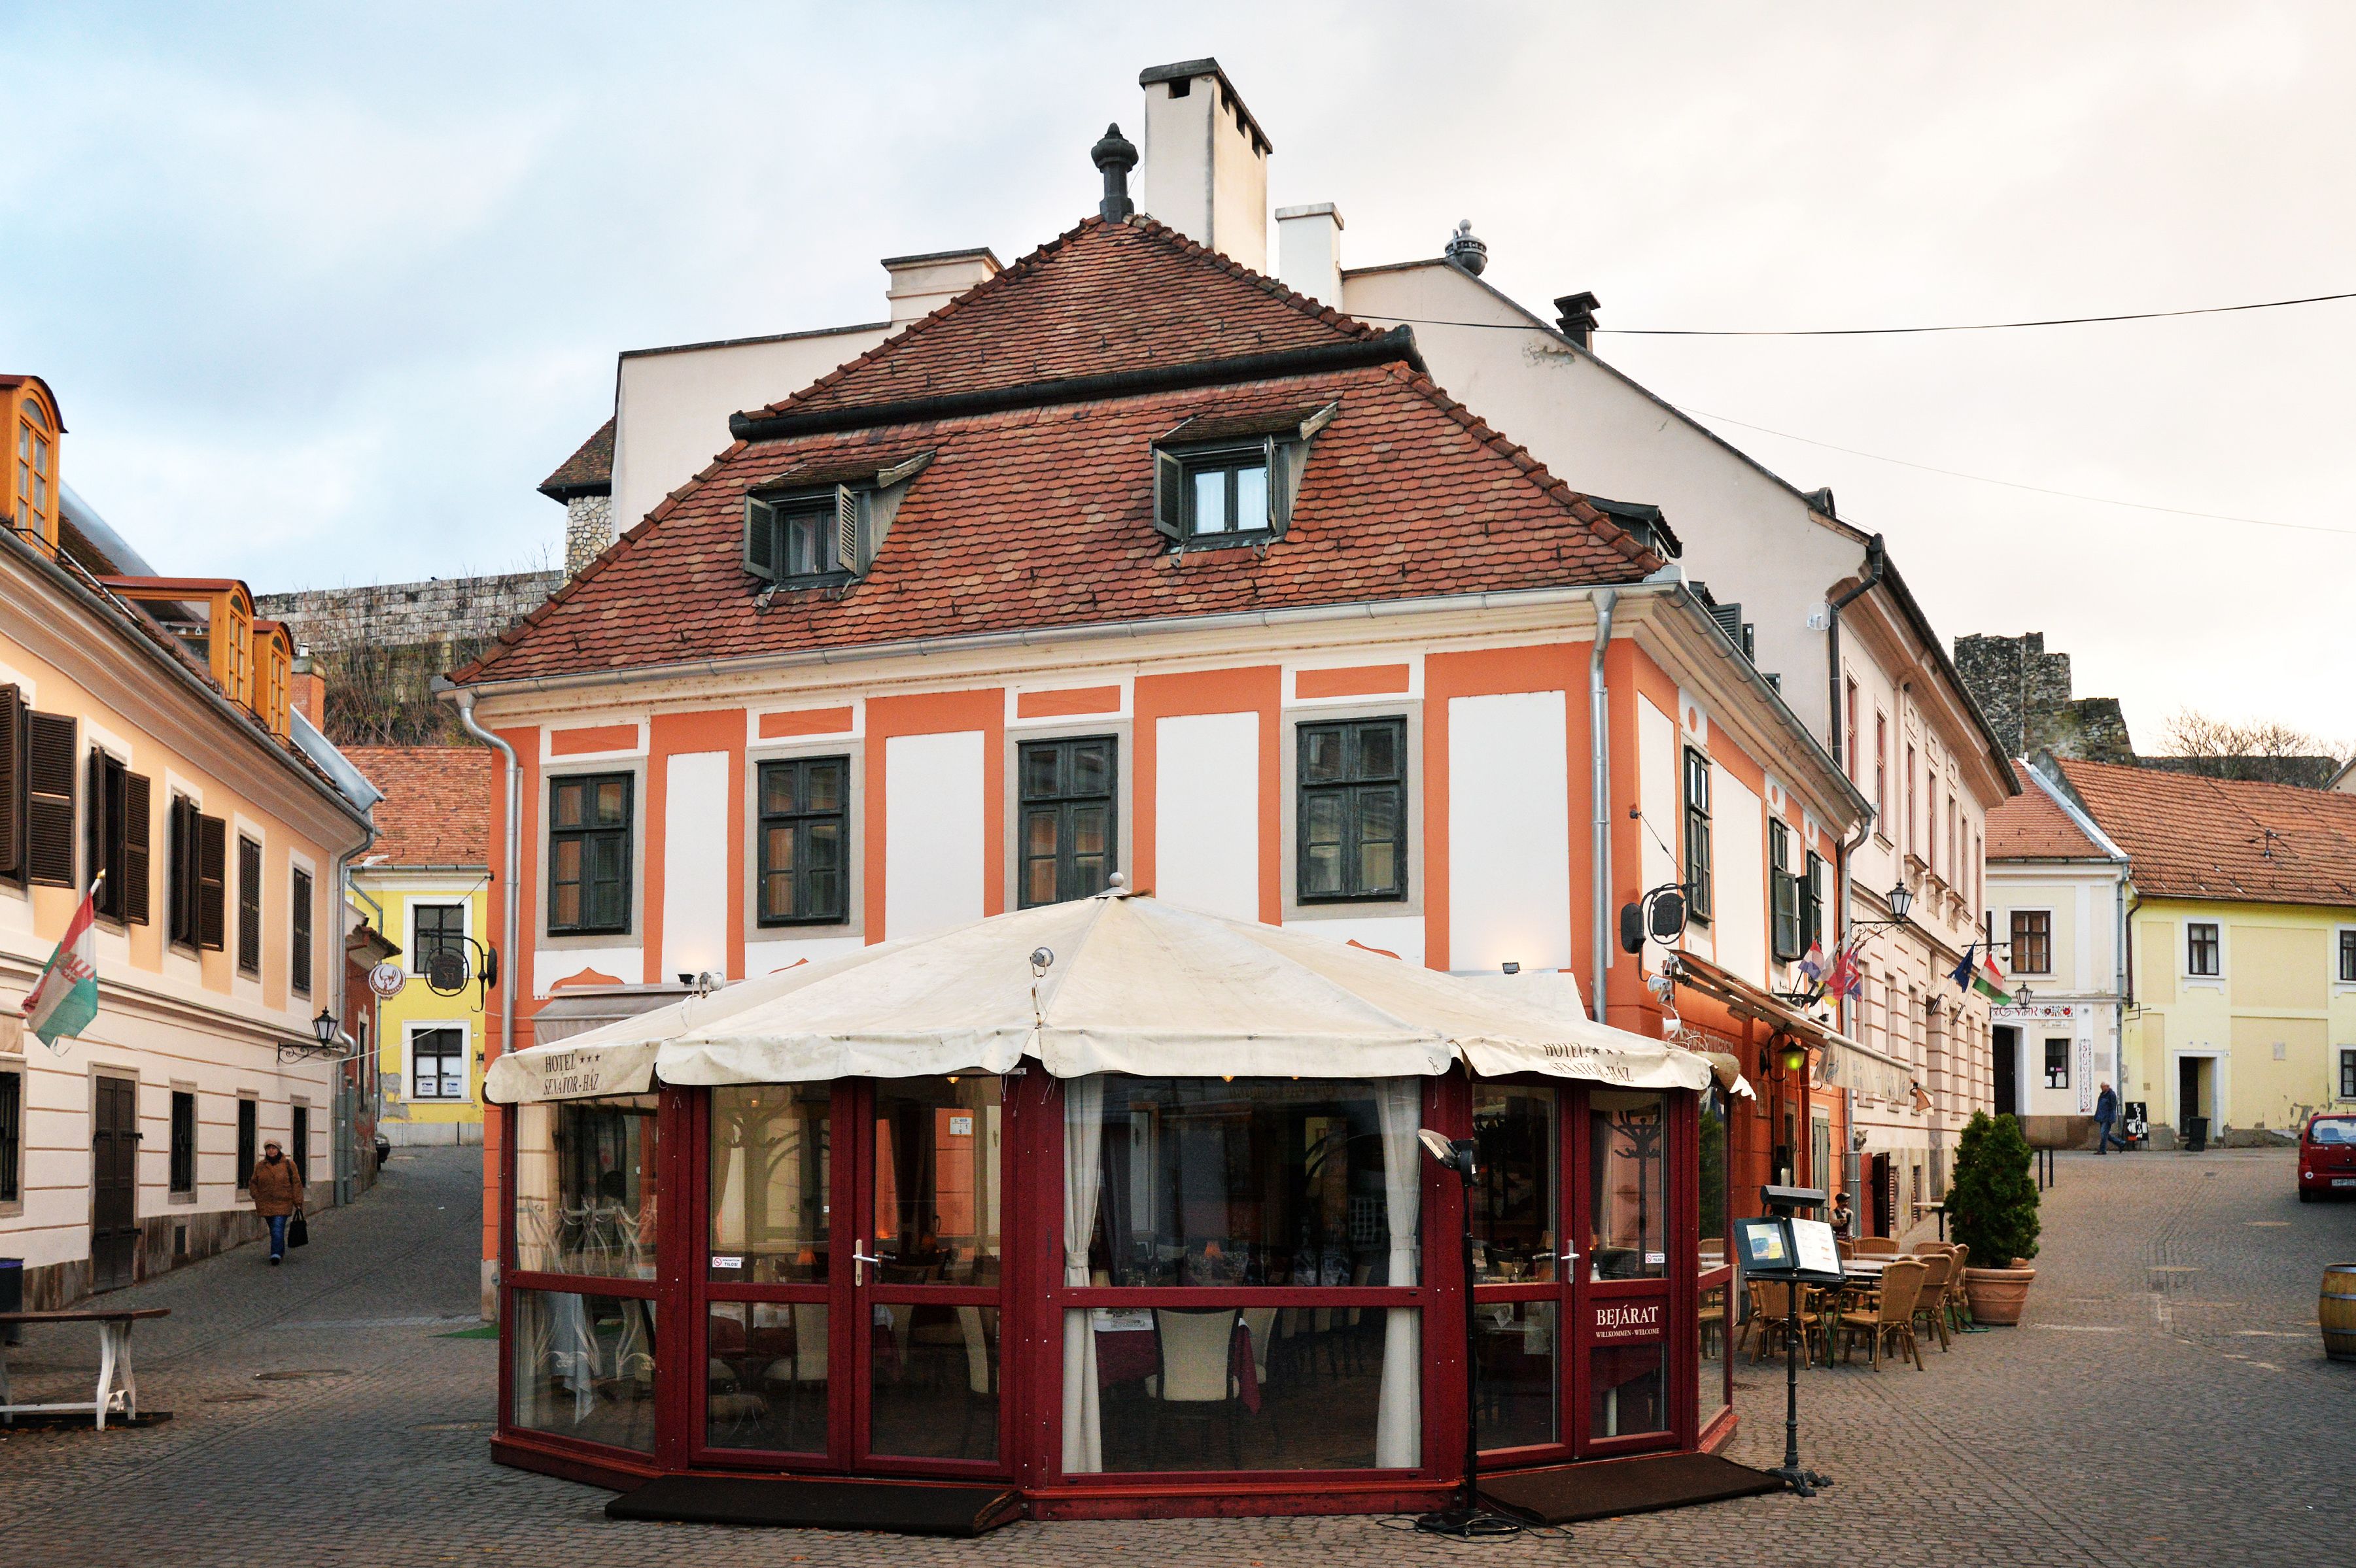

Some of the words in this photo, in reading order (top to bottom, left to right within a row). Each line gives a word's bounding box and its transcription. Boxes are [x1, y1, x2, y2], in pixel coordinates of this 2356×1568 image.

[1542, 1042, 1587, 1058] HOTEL
[545, 1053, 576, 1072] HOTEL
[1596, 1304, 1659, 1329] BEJÁRAT
[1596, 1329, 1631, 1338] WILLKOMMEN
